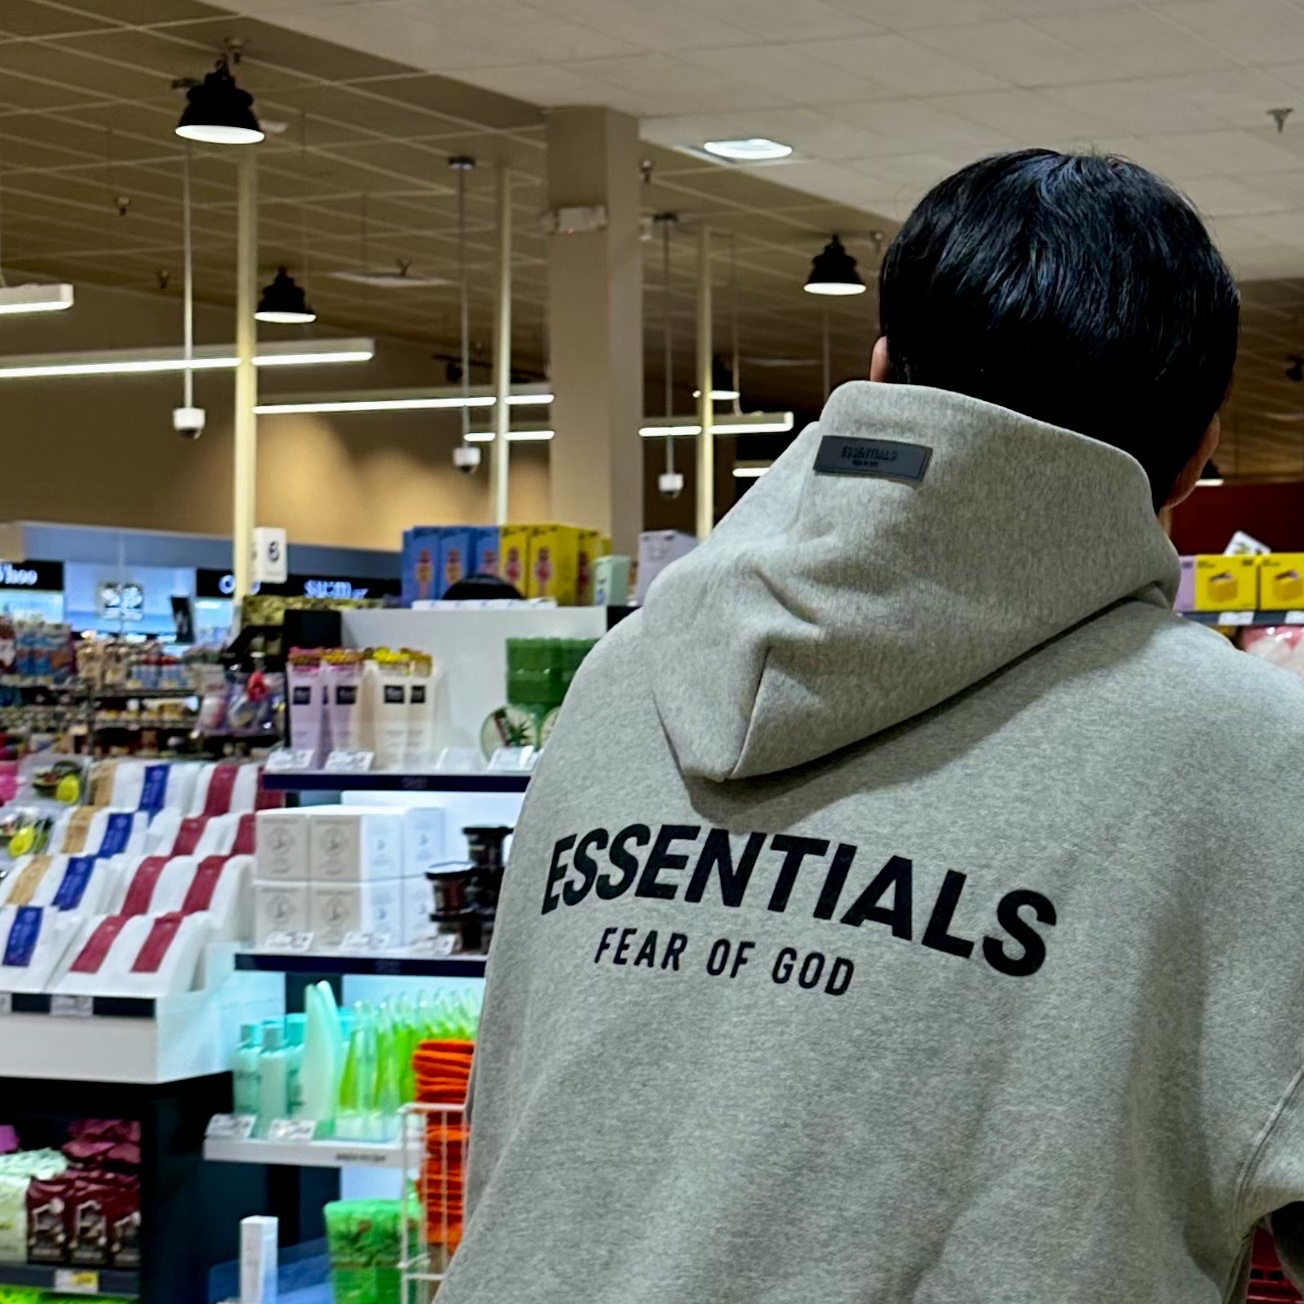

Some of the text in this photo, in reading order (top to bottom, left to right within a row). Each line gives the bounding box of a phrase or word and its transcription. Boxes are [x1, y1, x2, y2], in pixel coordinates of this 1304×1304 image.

[540, 823, 1058, 978] ESSENTIALS
[593, 927, 854, 996] FEAR OF GOD
